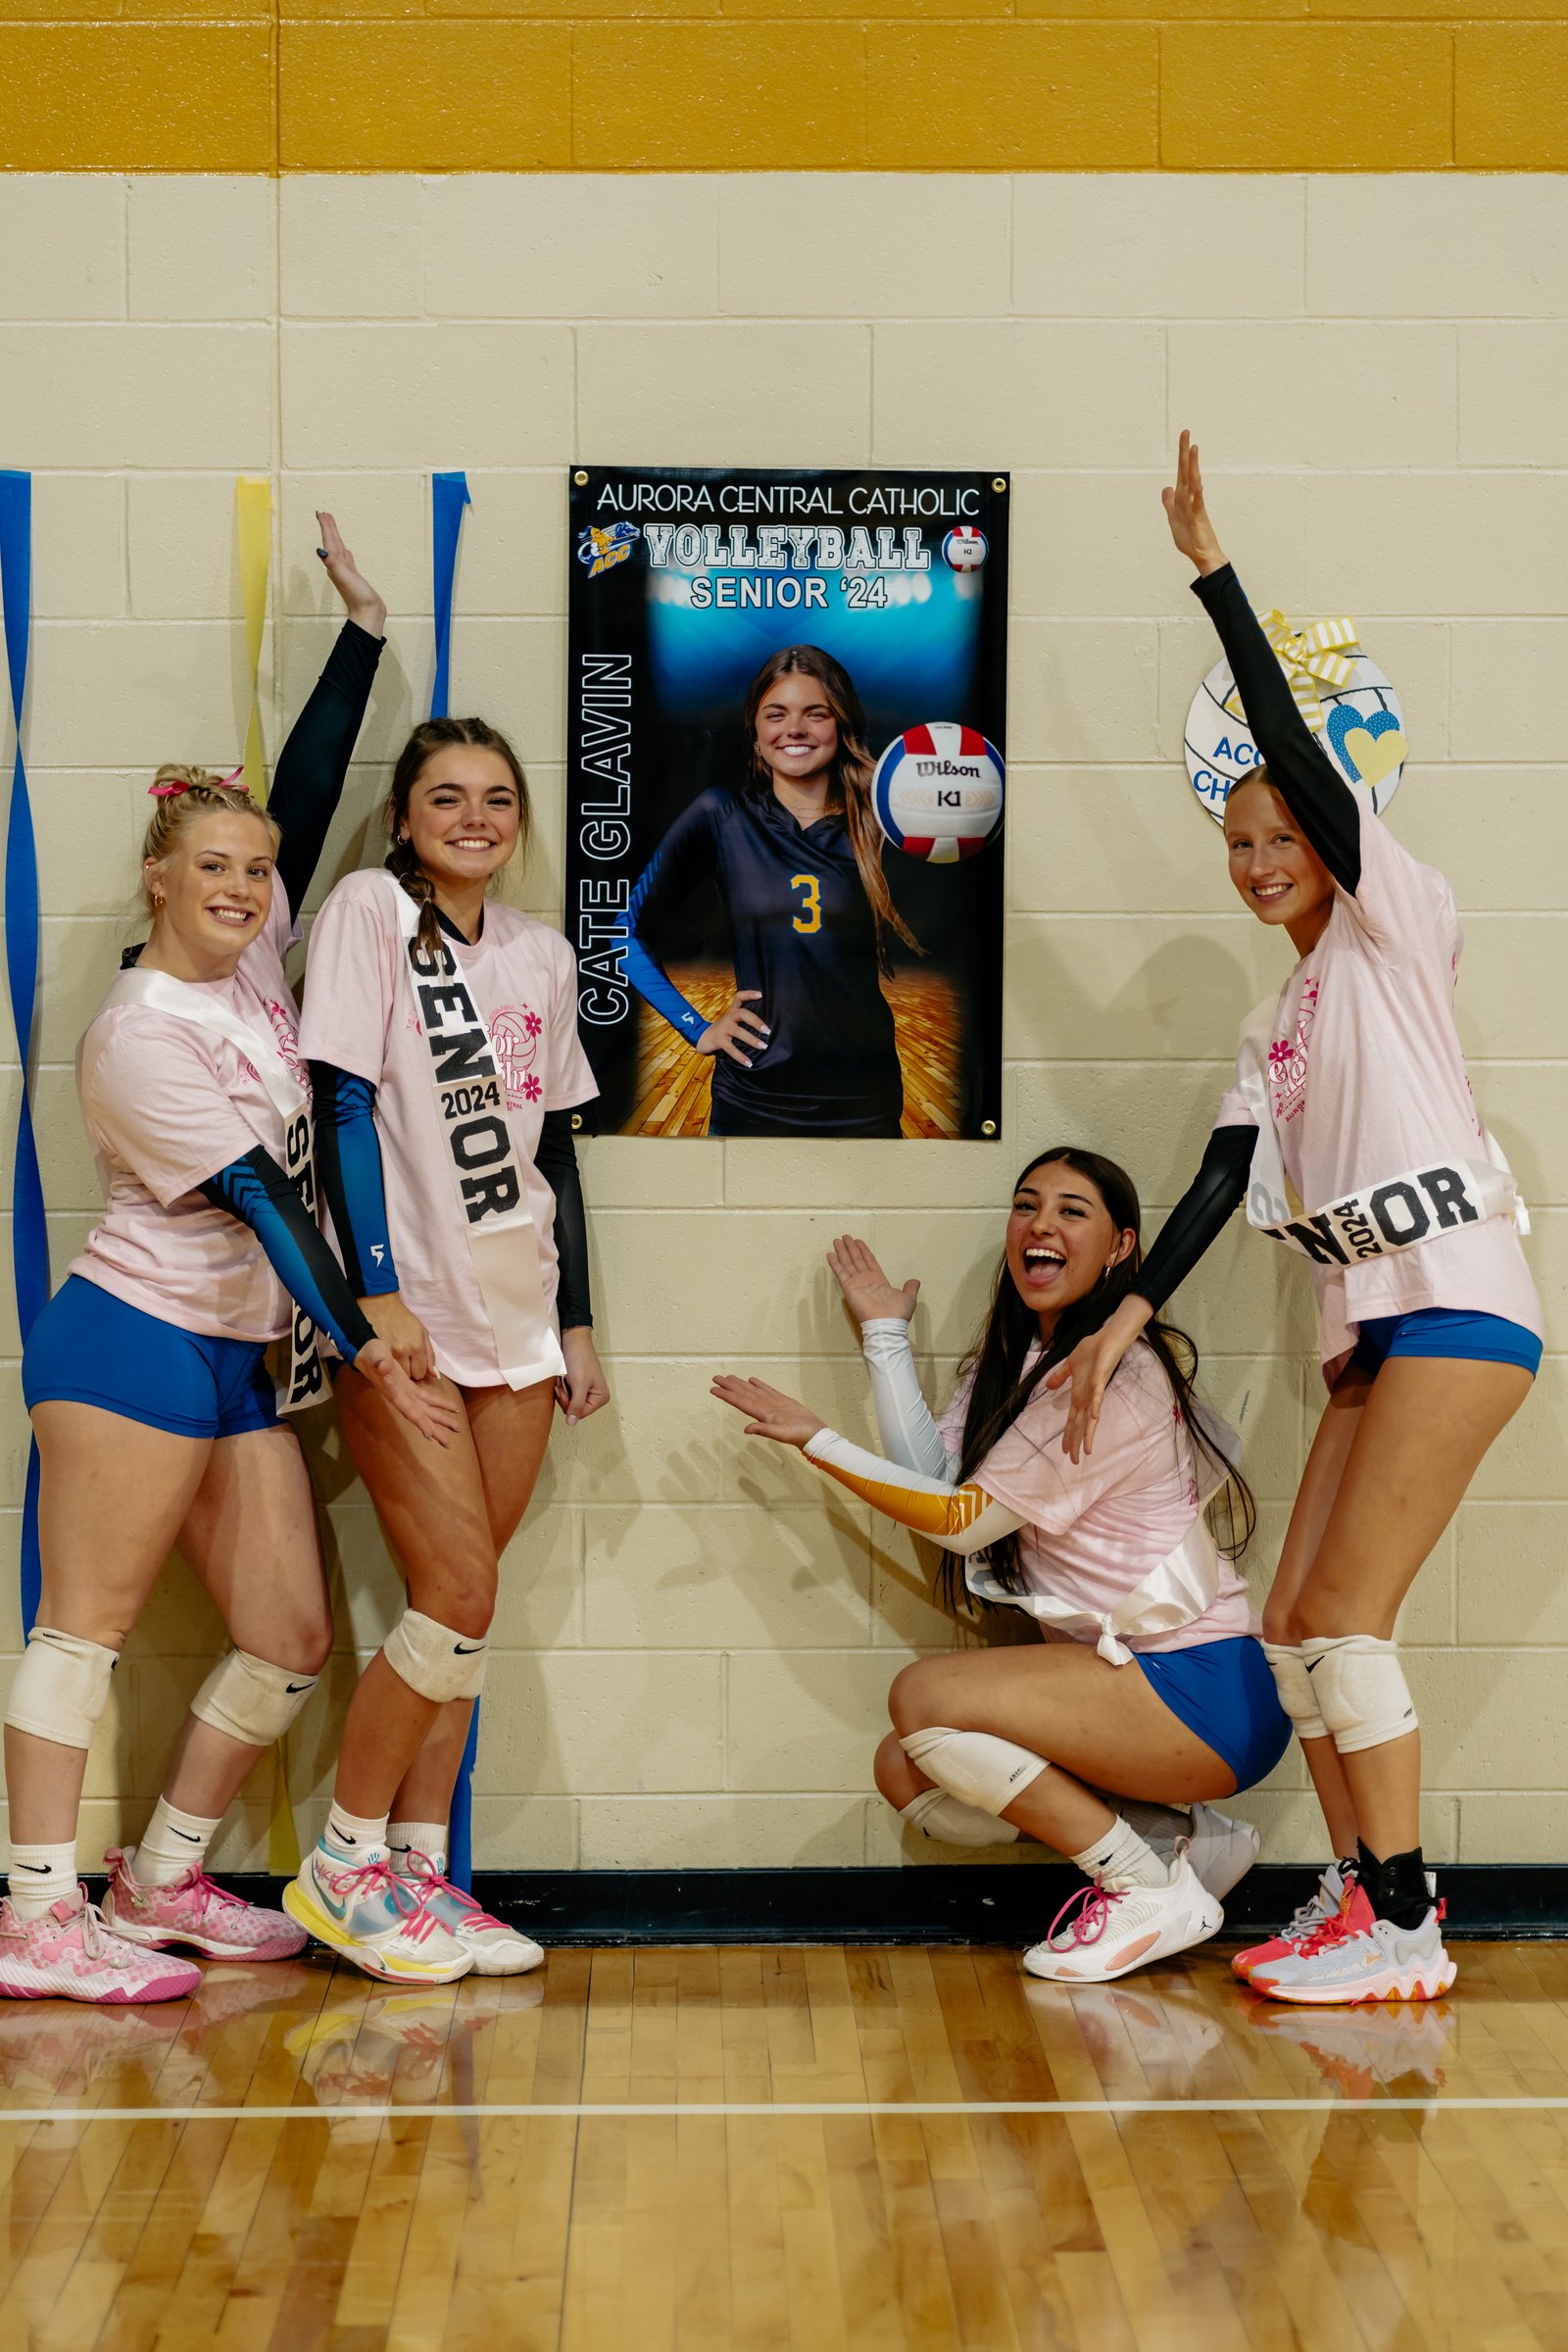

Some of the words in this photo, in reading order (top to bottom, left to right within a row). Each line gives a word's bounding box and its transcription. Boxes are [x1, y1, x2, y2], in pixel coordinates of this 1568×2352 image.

[596, 483, 715, 513] AURORA
[719, 485, 844, 514] CENTRAL
[849, 488, 980, 516] CATHOLIC
[588, 544, 631, 579] ACC
[643, 522, 932, 571] VOLLEYBALL
[690, 577, 830, 610] SENIOR
[579, 654, 632, 860] GLAVIN
[915, 760, 981, 778] Wilson
[1193, 770, 1231, 802] CH
[790, 873, 822, 935] 3
[578, 879, 629, 1026] CATE
[441, 1081, 501, 1120] 2024
[1333, 1198, 1384, 1259] 2024
